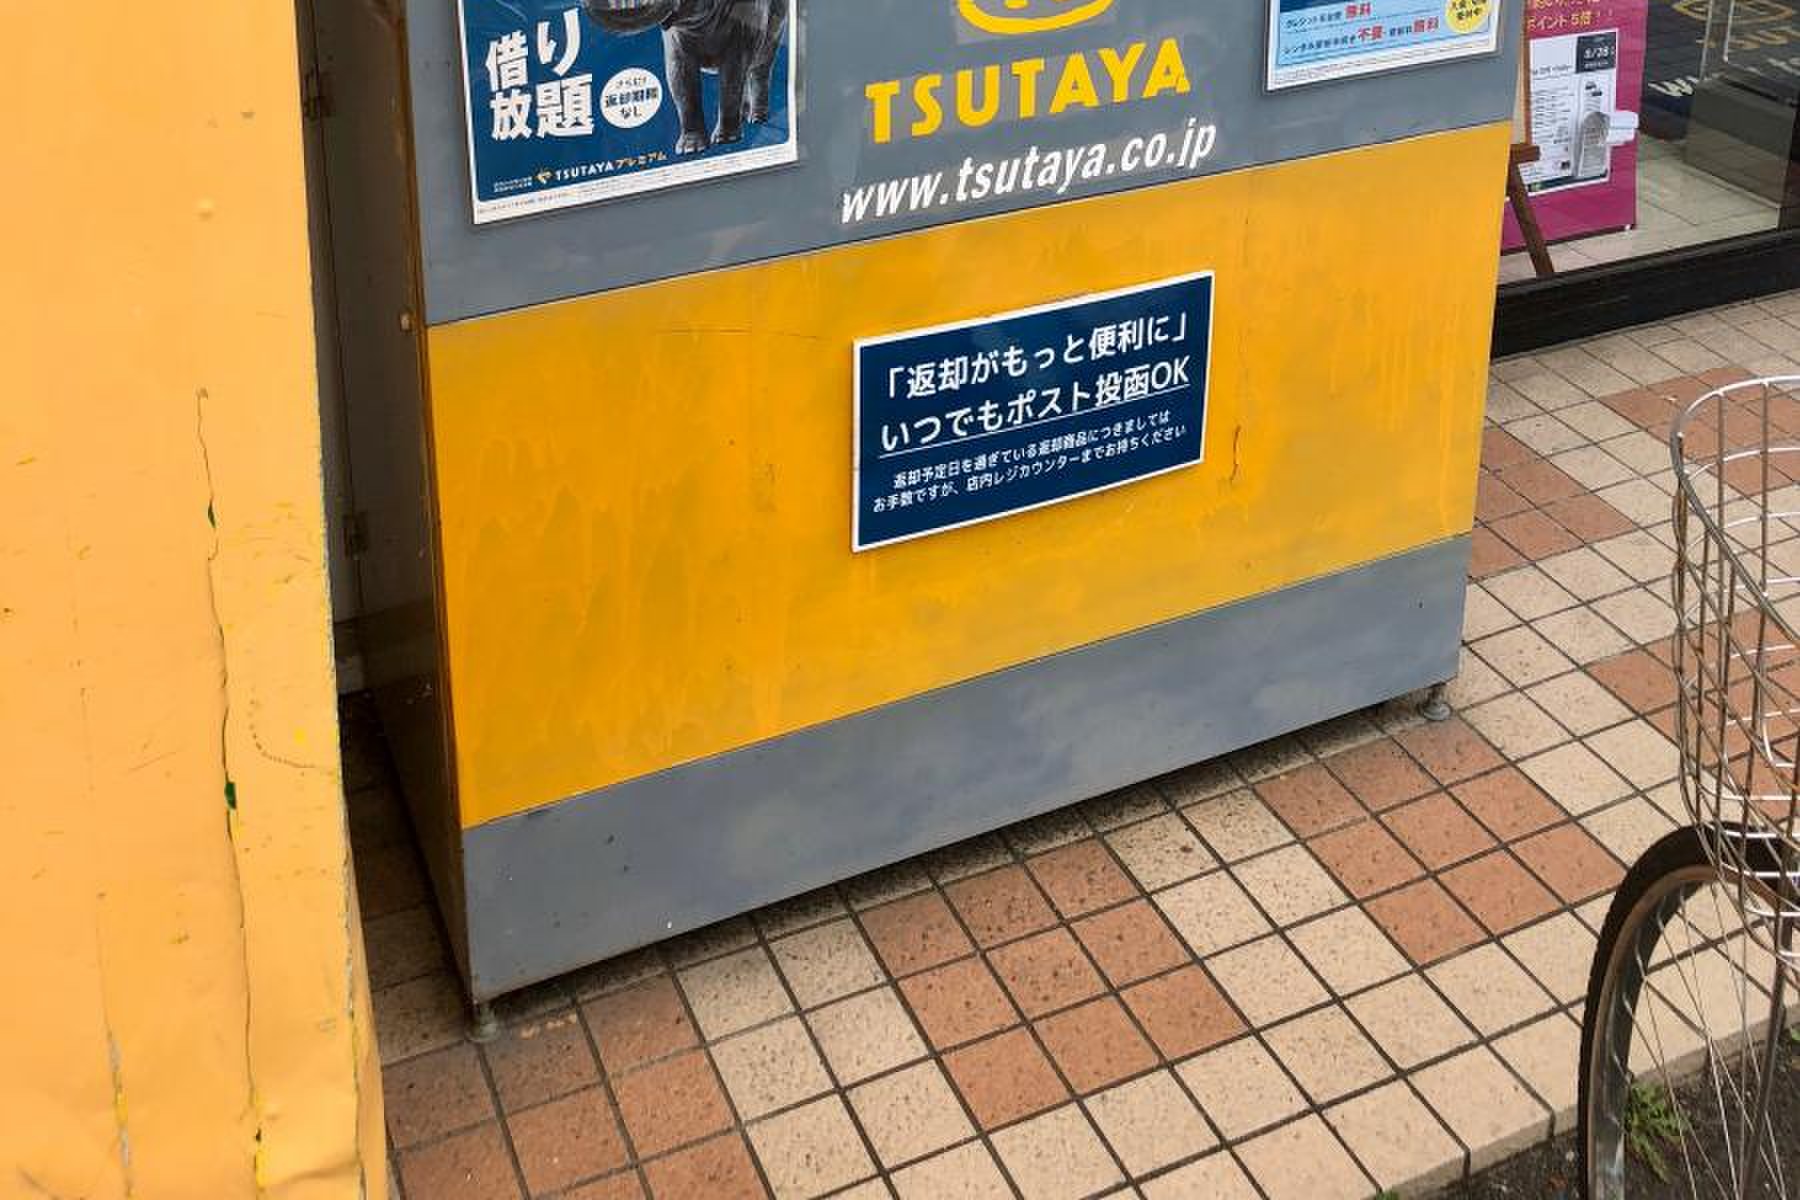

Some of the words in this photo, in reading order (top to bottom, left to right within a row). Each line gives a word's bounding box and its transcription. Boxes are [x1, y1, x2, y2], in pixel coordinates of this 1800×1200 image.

[485, 7, 581, 92] 借り
[865, 37, 1191, 144] TSUTAYA
[490, 72, 594, 141] 放題
[841, 117, 1217, 224] www.tsutaya.co.jp
[886, 312, 1187, 400] 「返却がもっと便利に」
[881, 355, 1191, 453] いつでもポスト投函OK
